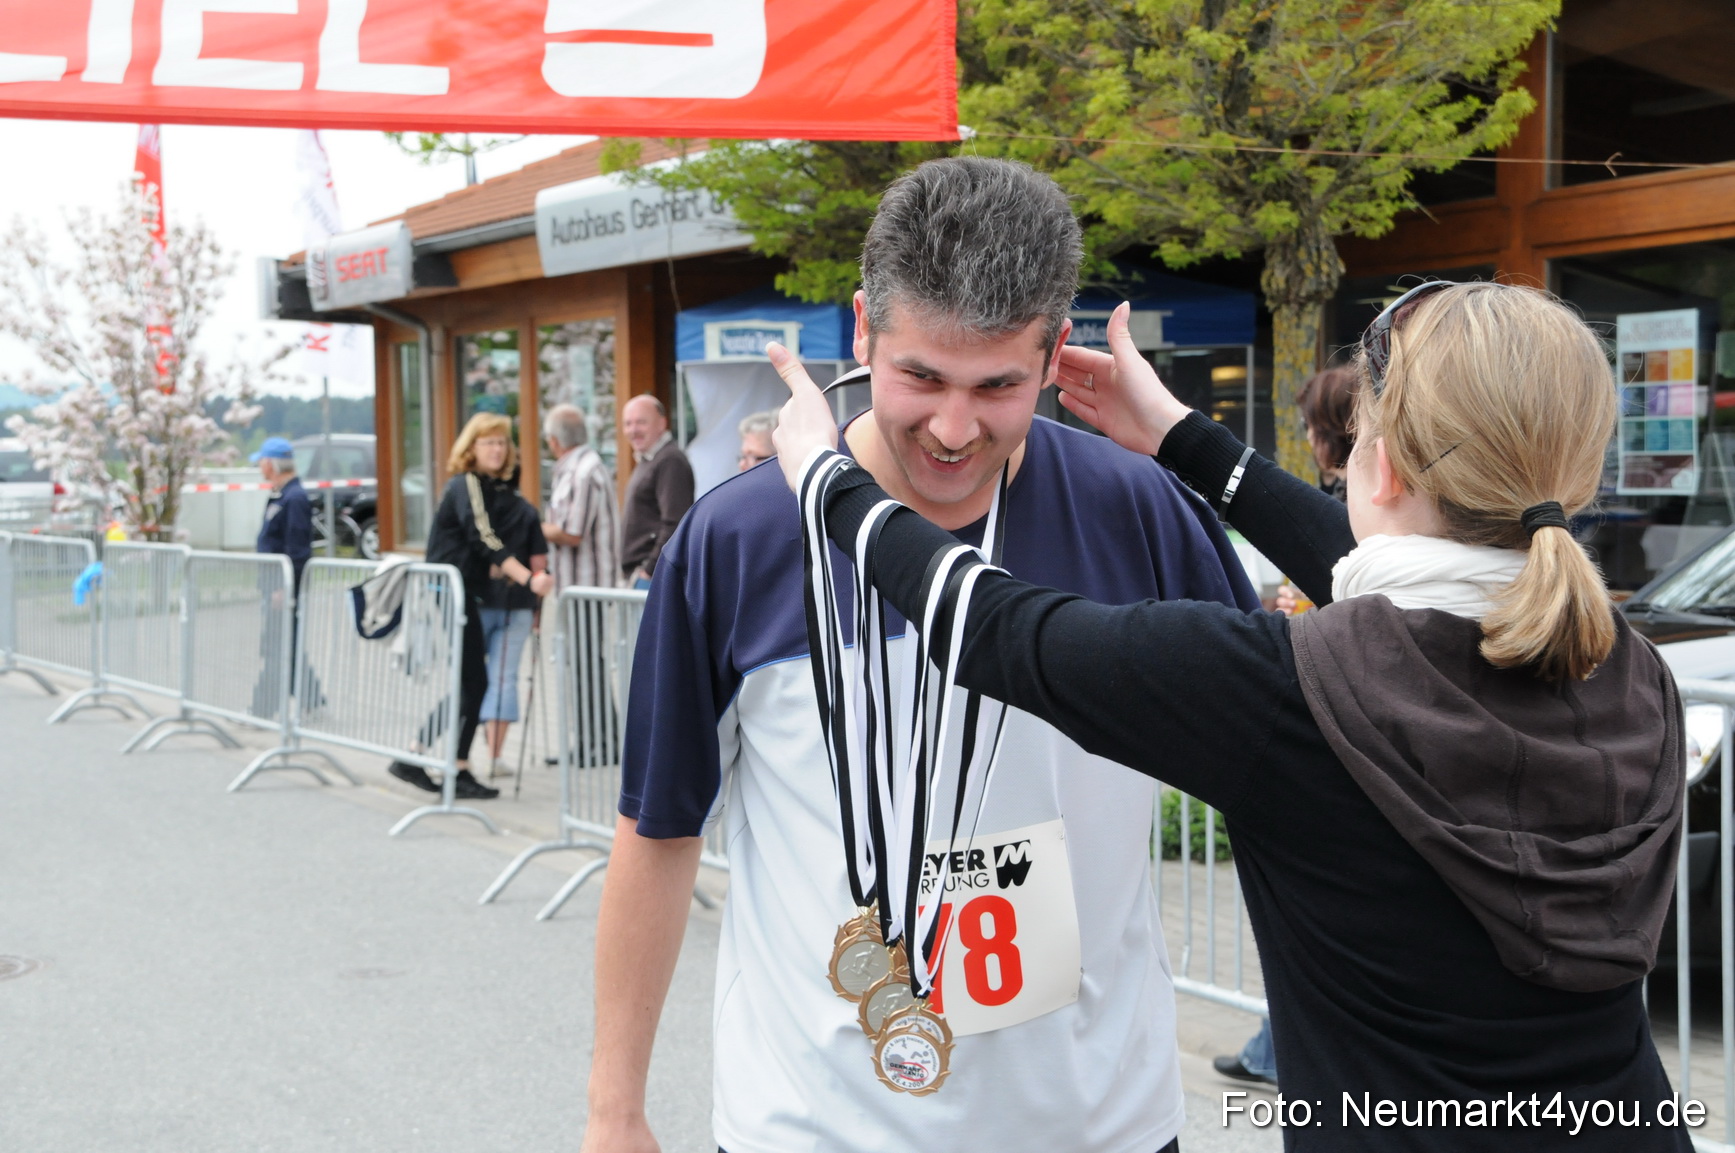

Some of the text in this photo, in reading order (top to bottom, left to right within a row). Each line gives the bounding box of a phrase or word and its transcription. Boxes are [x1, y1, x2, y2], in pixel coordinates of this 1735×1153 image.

[0, 0, 449, 95] IEL
[551, 208, 625, 246] Autohaus
[630, 190, 704, 230] Gerhart
[336, 247, 390, 283] SEAT
[922, 849, 988, 876] EYER
